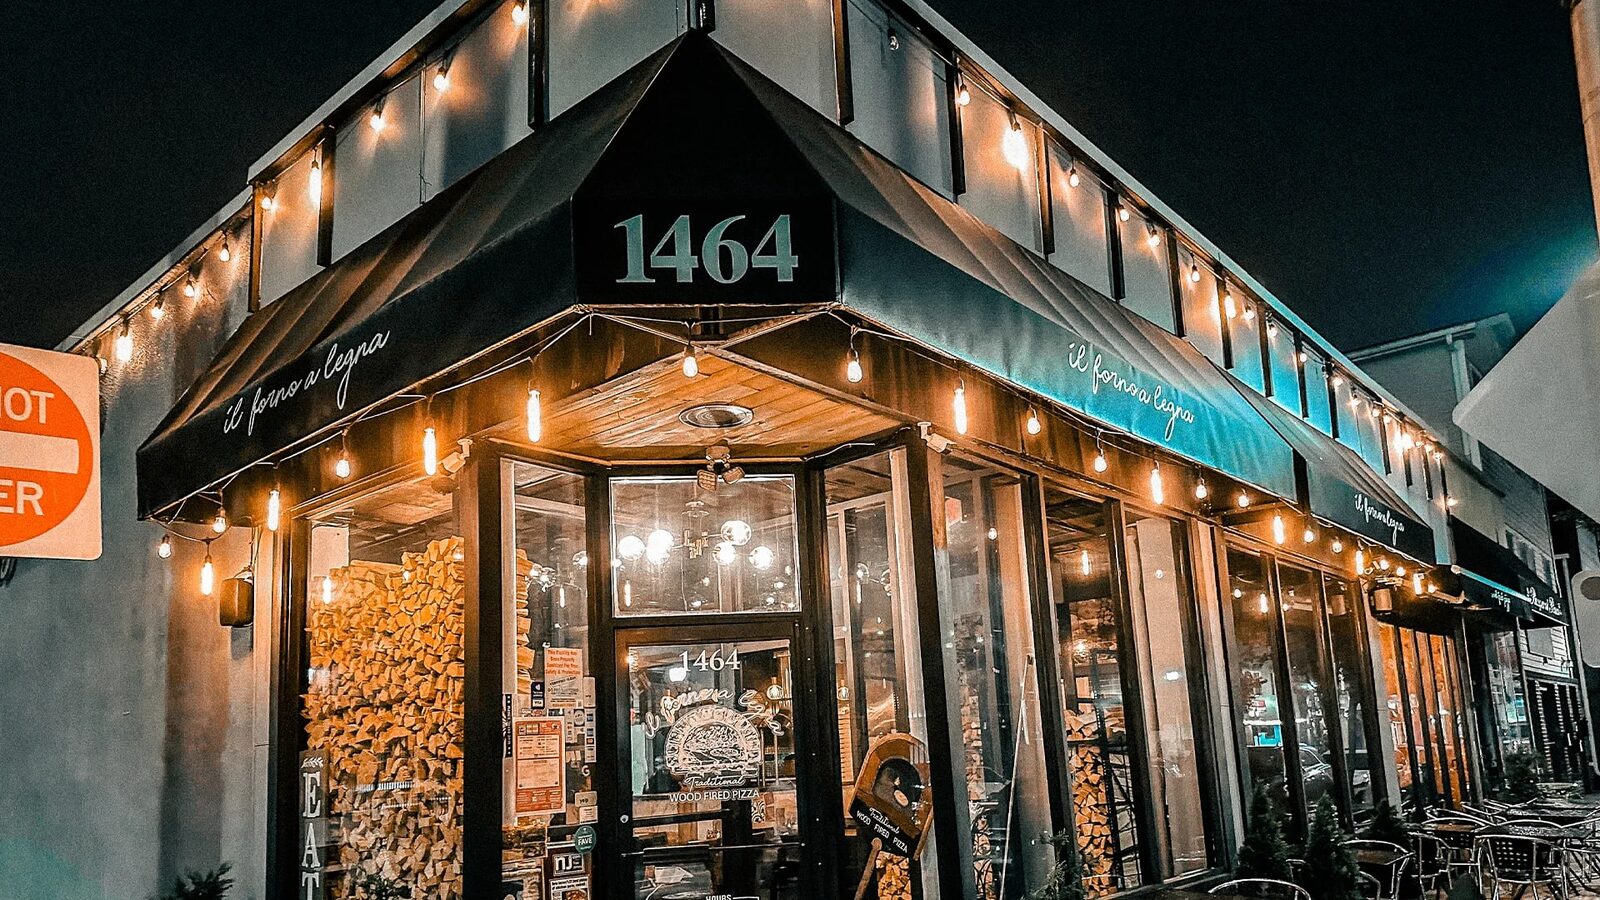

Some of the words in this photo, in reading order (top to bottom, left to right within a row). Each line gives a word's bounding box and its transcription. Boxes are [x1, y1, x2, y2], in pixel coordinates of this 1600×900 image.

[614, 214, 799, 284] 1464
[223, 397, 244, 434] il
[248, 378, 303, 436] forno
[304, 368, 321, 390] a
[324, 330, 390, 410] legna
[1068, 342, 1088, 372] il
[1092, 353, 1138, 394] forno
[1138, 389, 1152, 404] a
[1153, 385, 1194, 442] legna
[0, 386, 55, 424] OT
[679, 648, 741, 672] 1464
[670, 792, 702, 802] WOOD
[703, 790, 731, 801] FIRED
[733, 789, 760, 801] PIZZA
[684, 775, 744, 792] Traditional
[578, 836, 593, 846] FAVE
[857, 810, 871, 825] WOOD
[874, 823, 890, 839] FIRED
[893, 837, 908, 853] PIZZA
